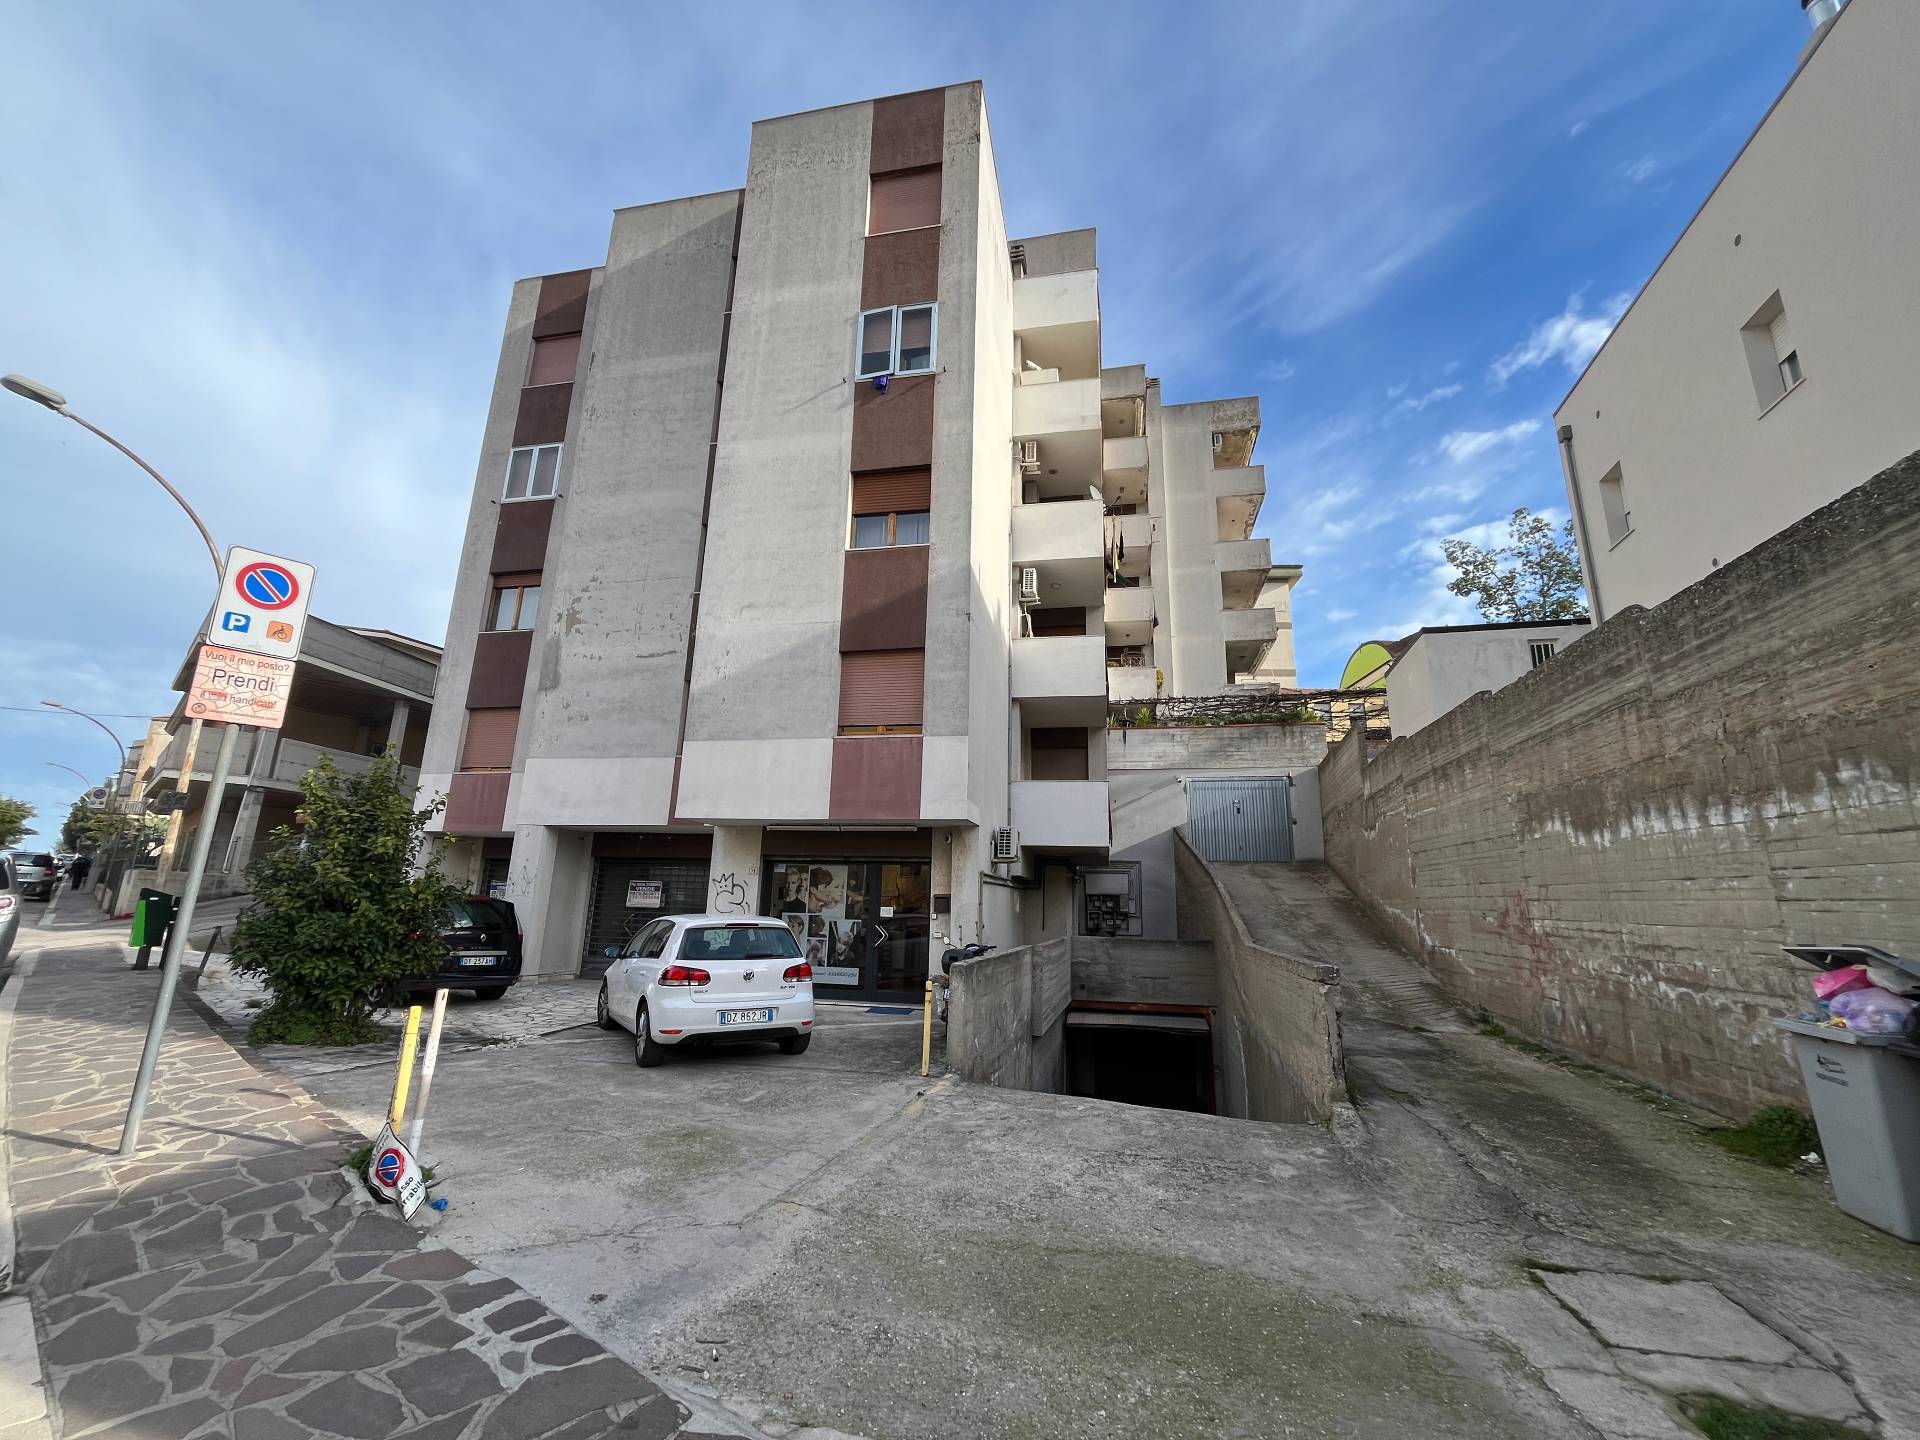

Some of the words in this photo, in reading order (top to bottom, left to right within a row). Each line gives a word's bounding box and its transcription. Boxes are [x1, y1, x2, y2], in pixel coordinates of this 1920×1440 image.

[228, 614, 246, 630] P
[205, 650, 227, 661] Vuoi
[229, 655, 235, 663] il
[237, 657, 255, 667] mio
[257, 661, 290, 672] posto?
[211, 668, 276, 692] Prendi
[726, 1012, 738, 1023] DZ
[740, 1011, 768, 1022] 862JR
